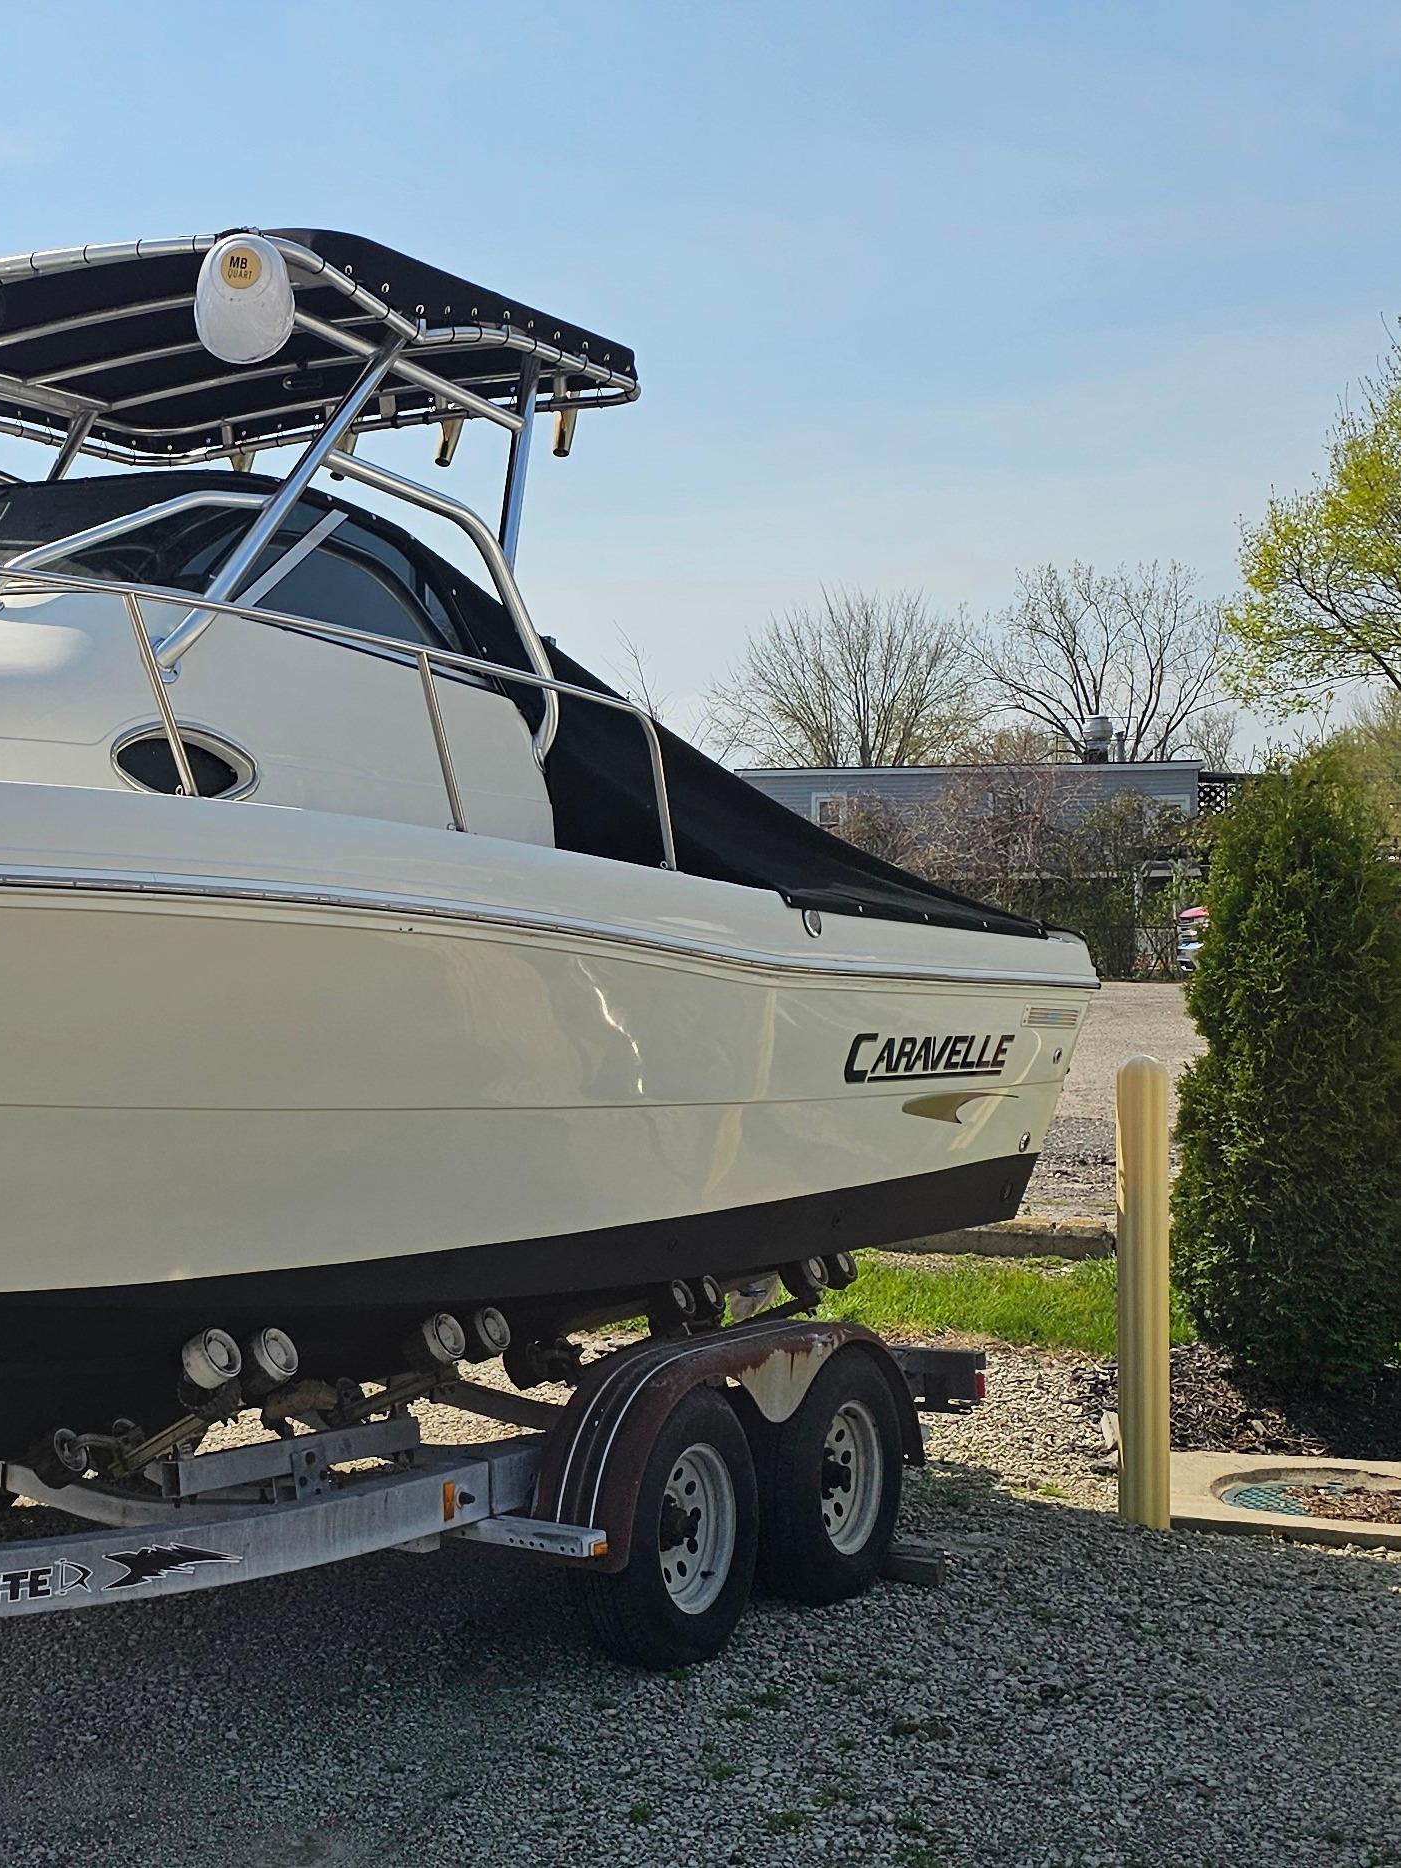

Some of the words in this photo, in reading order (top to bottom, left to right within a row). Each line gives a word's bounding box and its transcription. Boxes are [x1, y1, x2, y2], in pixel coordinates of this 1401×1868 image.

[229, 256, 248, 269] MB
[227, 268, 252, 280] QUART
[844, 1032, 1015, 1084] CARAVELLE
